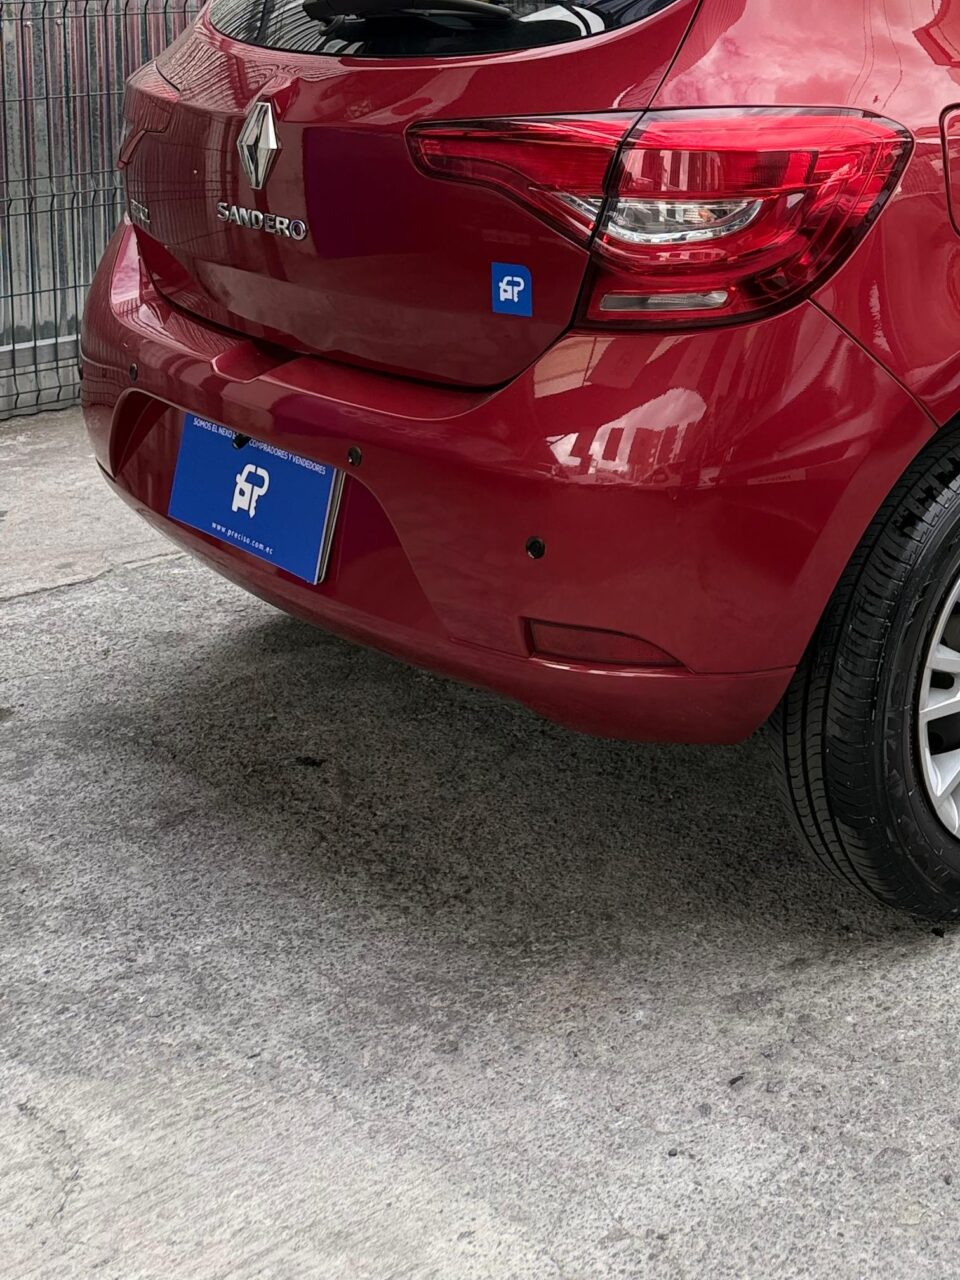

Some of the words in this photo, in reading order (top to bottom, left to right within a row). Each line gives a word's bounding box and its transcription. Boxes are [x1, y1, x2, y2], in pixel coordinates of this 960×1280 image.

[216, 201, 308, 241] SANDERO
[193, 417, 212, 431] SOMOS
[211, 423, 218, 433] EL
[218, 426, 233, 438] NEXO
[248, 438, 289, 460] COMPRADORES
[292, 455, 326, 475] VENDEDORES
[211, 521, 274, 556] www.preciso.com.ec
